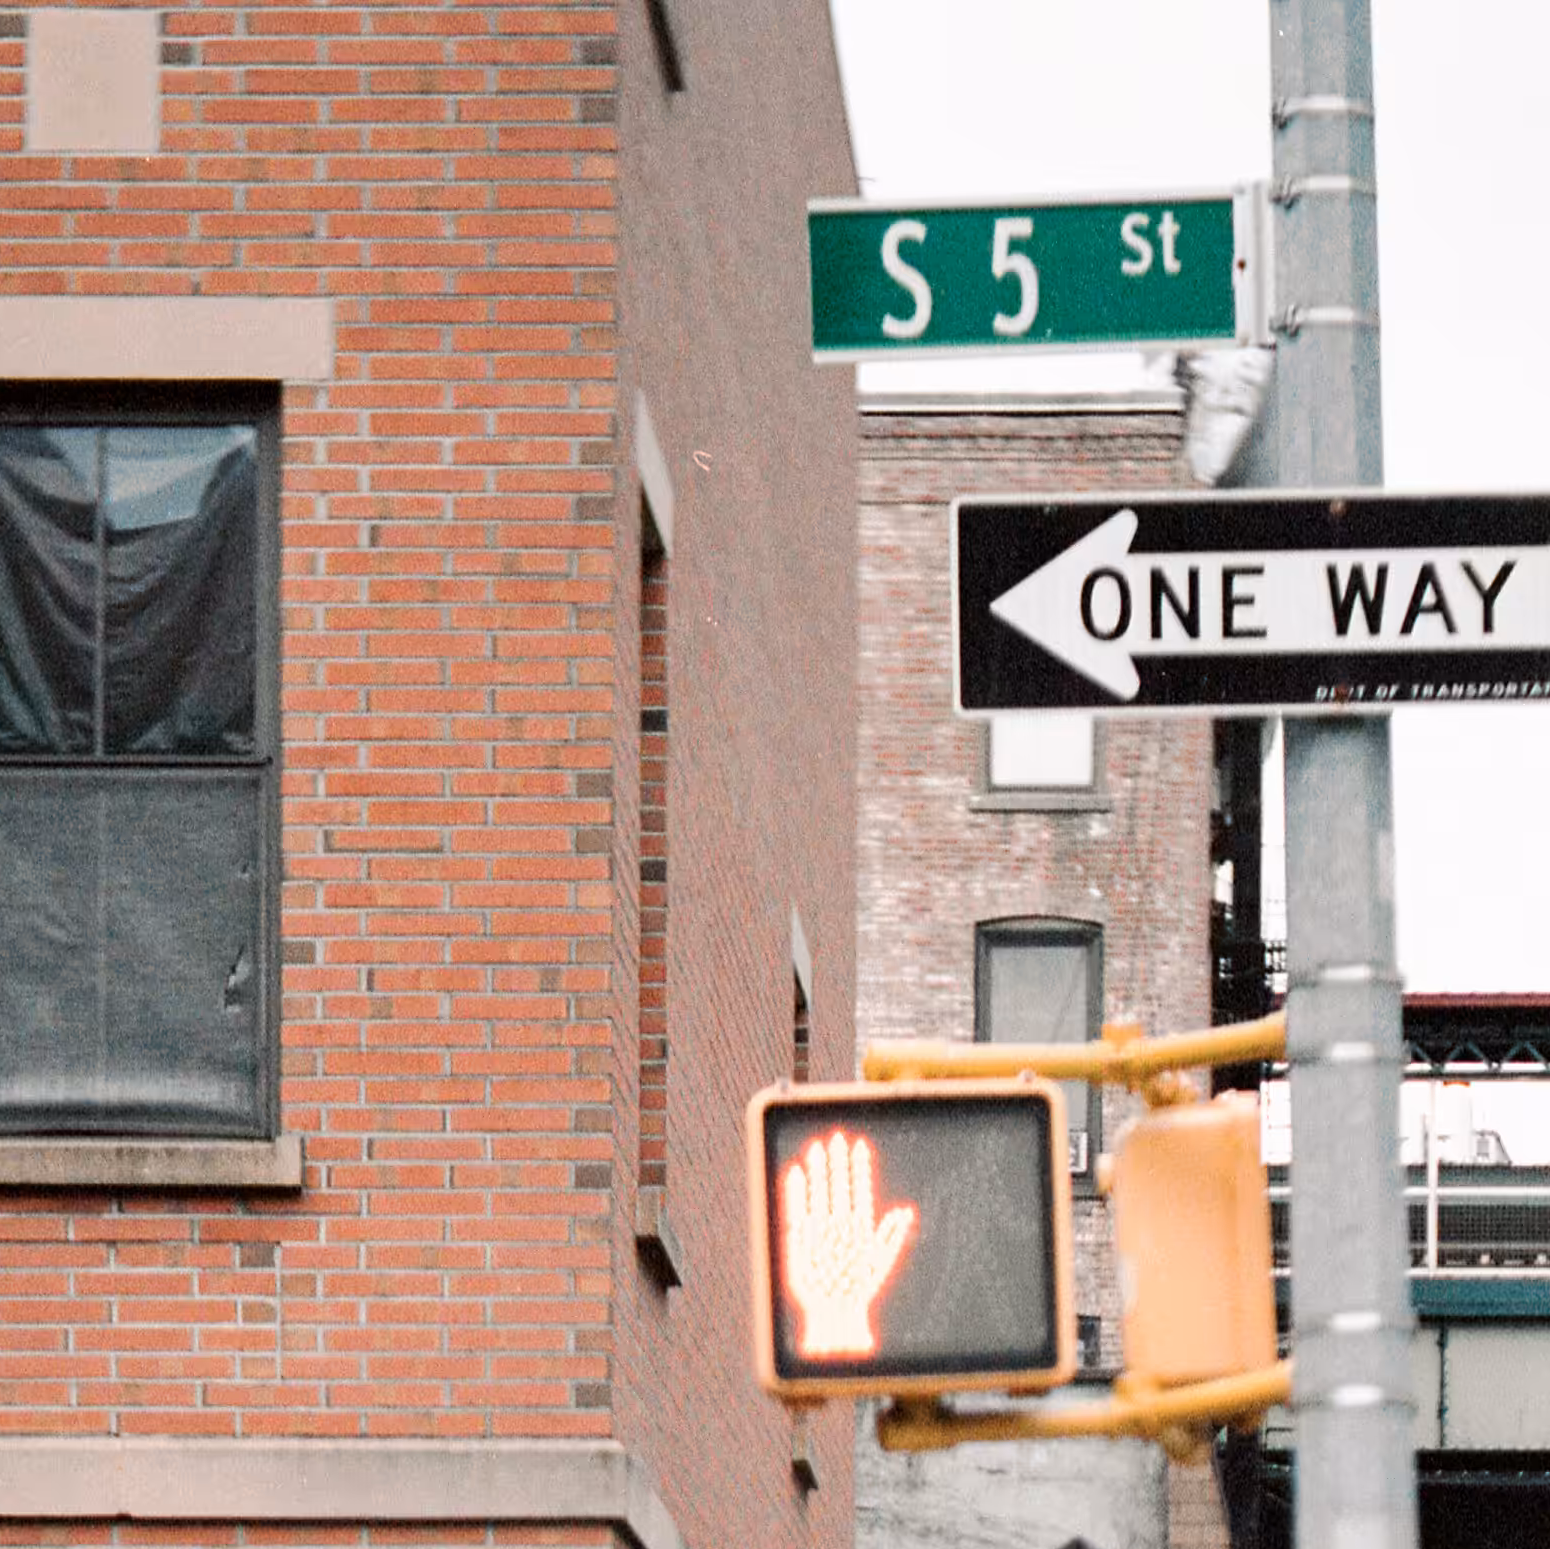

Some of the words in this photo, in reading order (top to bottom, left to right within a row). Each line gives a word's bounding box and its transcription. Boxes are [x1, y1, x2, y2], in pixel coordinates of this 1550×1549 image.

[881, 219, 933, 340] S
[991, 217, 1041, 338] 5
[1120, 212, 1181, 276] St
[1080, 566, 1267, 642] ONE
[1326, 561, 1516, 637] WAY
[1316, 684, 1366, 699] DT
[1375, 683, 1400, 698] OF
